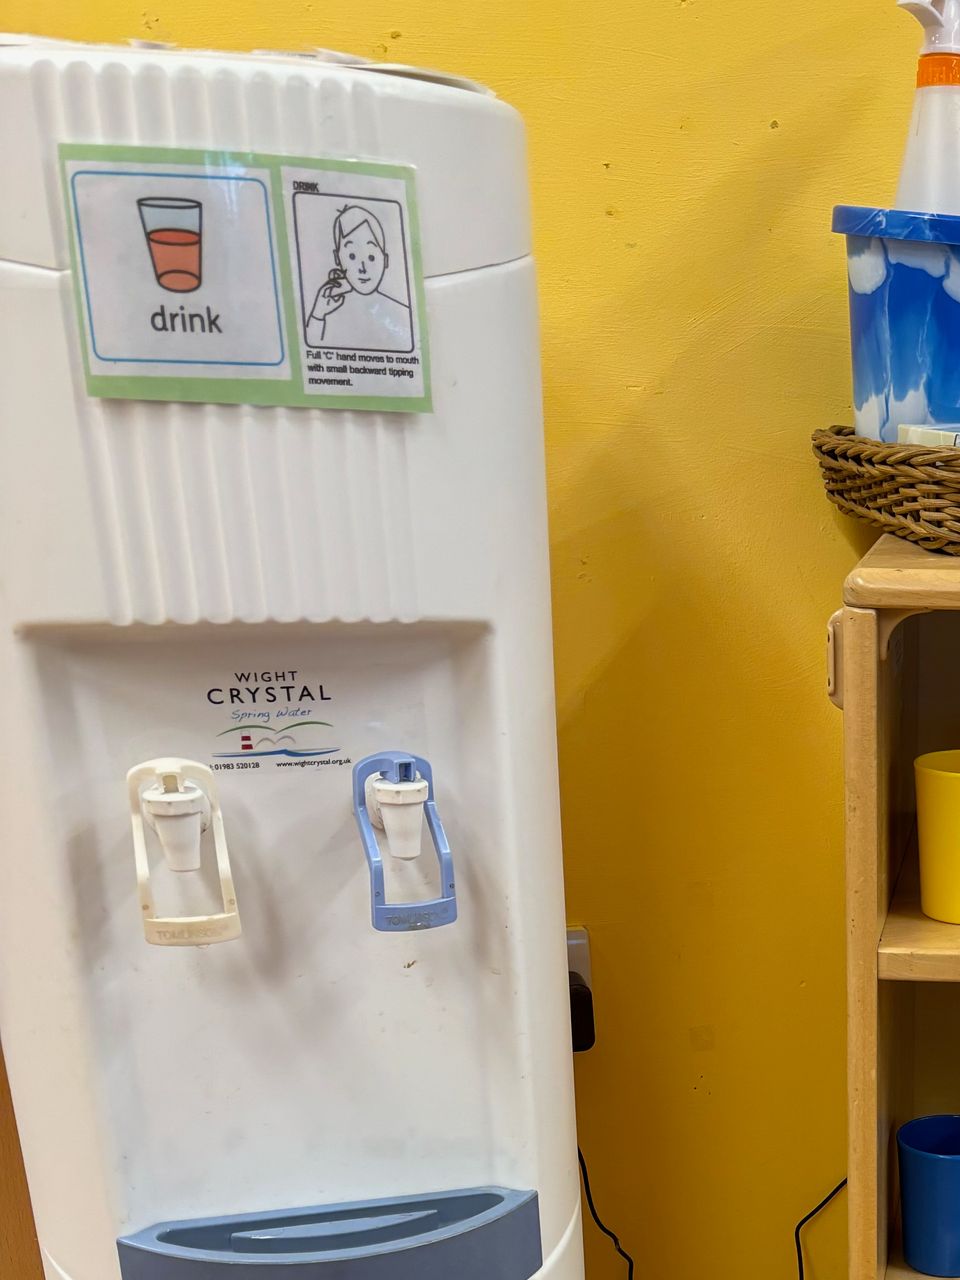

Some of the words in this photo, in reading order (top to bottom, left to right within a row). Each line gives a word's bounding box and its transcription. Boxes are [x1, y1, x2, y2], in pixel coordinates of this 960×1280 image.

[150, 304, 222, 334] drink
[306, 350, 321, 360] Full
[336, 352, 356, 362] hand
[358, 355, 385, 363] moves
[386, 355, 395, 364] to
[395, 356, 419, 365] mouth
[307, 364, 324, 373] with
[326, 365, 347, 374] small
[349, 365, 387, 376] backward
[389, 367, 414, 379] tipping
[308, 376, 353, 387] movement.
[234, 671, 298, 683] WIGHT
[207, 685, 332, 705] CRYSTAL
[231, 709, 271, 723] Spring
[276, 707, 312, 718] Water
[214, 762, 234, 771] 01983
[236, 761, 260, 770] 520128
[276, 758, 352, 768] www.wightcrystal.org.uk
